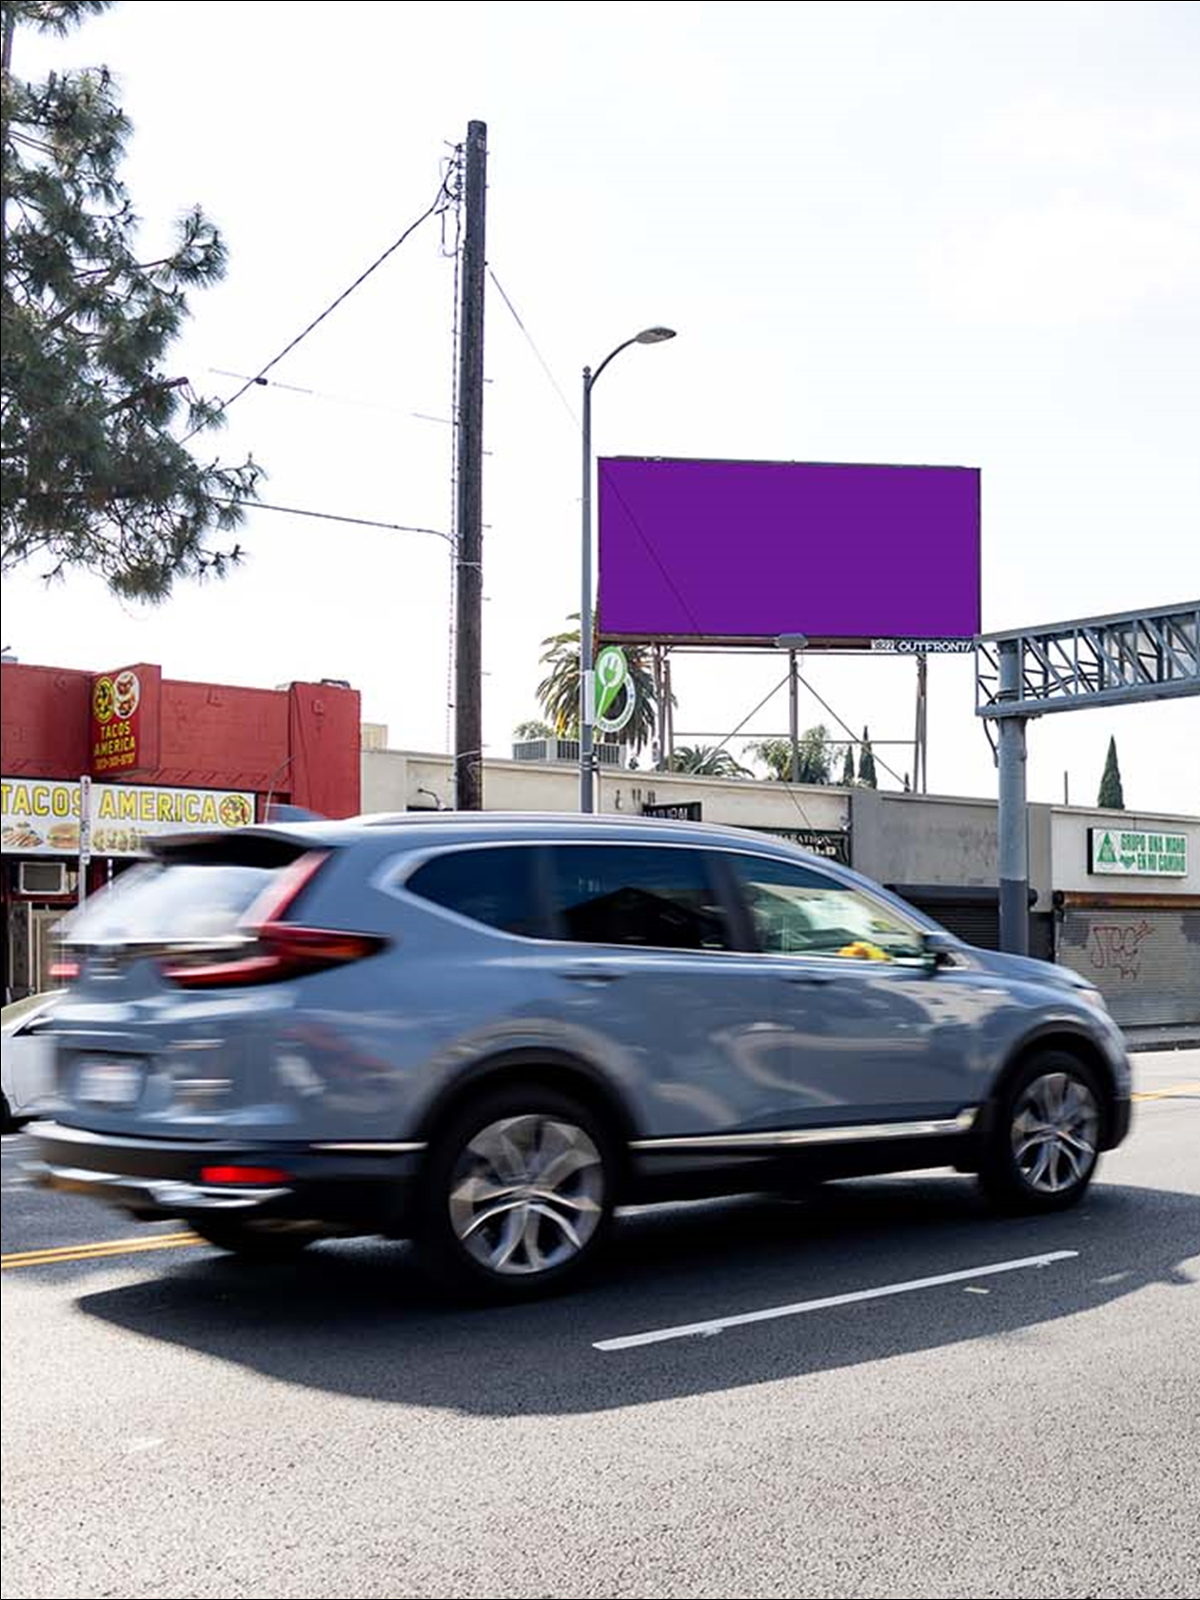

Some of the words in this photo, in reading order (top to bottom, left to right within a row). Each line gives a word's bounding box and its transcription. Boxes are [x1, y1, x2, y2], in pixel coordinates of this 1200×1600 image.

[100, 721, 131, 740] TACOS
[94, 736, 135, 756] AMERICA
[99, 790, 218, 823] AMERICA
[1120, 833, 1146, 851] GRUPO
[1148, 835, 1163, 852] UNA
[1165, 836, 1186, 854] MANO
